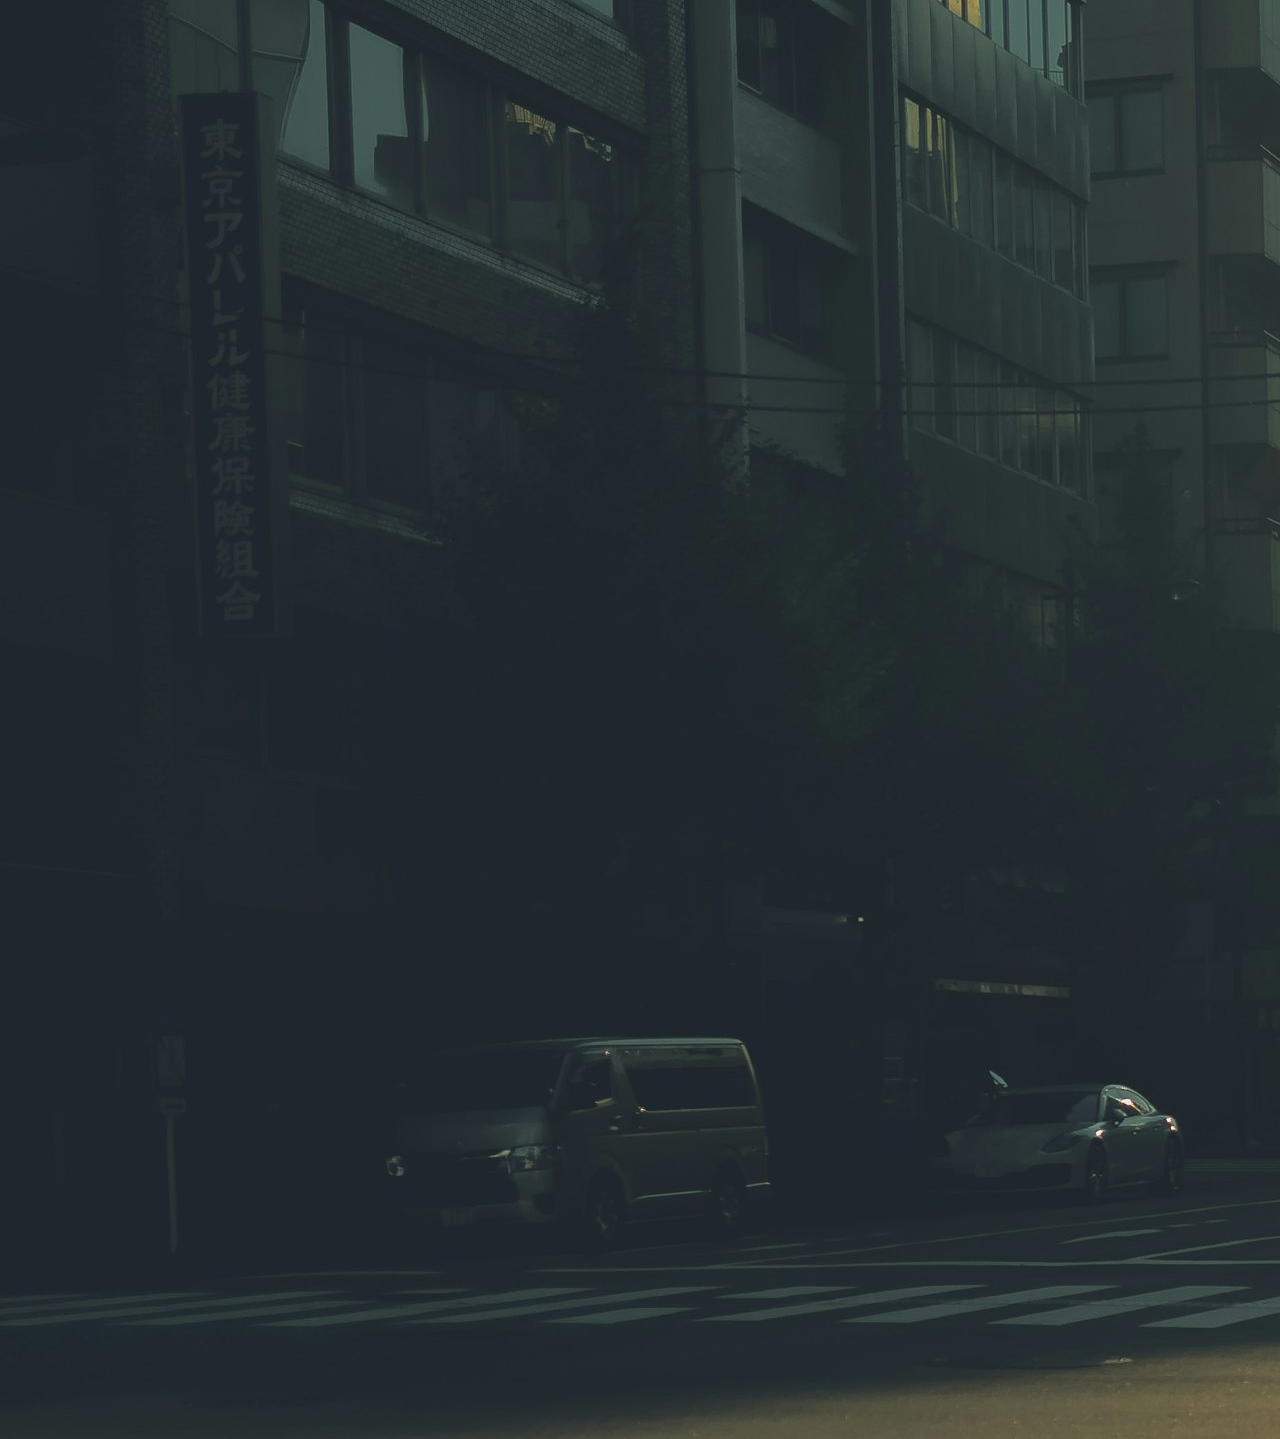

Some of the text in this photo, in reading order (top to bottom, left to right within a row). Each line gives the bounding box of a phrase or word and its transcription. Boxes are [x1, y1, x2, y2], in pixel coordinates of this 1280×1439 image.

[199, 117, 264, 625] 東京アパレル健康保険組合
